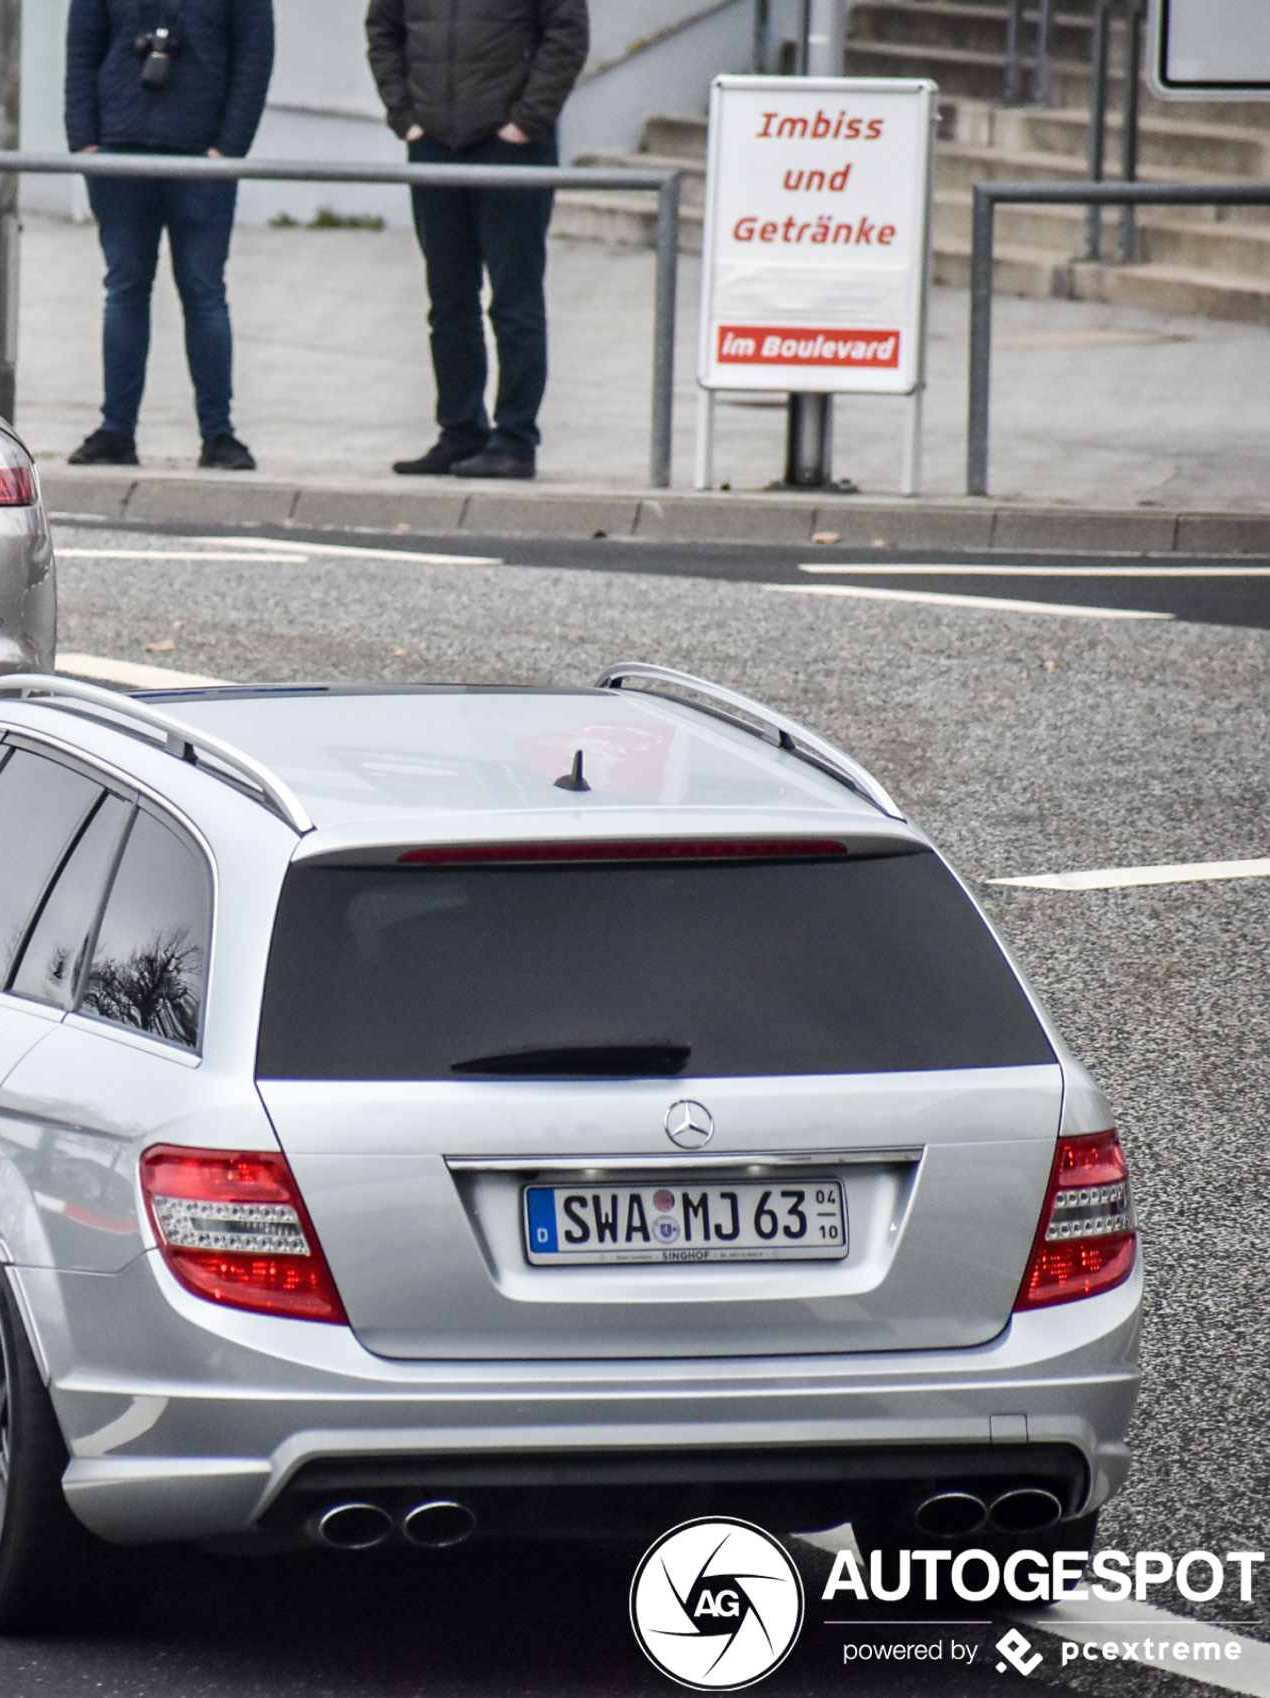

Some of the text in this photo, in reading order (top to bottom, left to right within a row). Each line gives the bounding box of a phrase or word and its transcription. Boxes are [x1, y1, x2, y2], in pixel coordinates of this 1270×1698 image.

[756, 110, 883, 140] Imbiss
[783, 163, 852, 192] und
[733, 215, 896, 245] Getränke
[722, 332, 896, 360] im Boulevard
[537, 1190, 836, 1244] D SWA MJ 63 04
[818, 1225, 838, 1239] 10
[662, 1249, 710, 1261] SINGHOF
